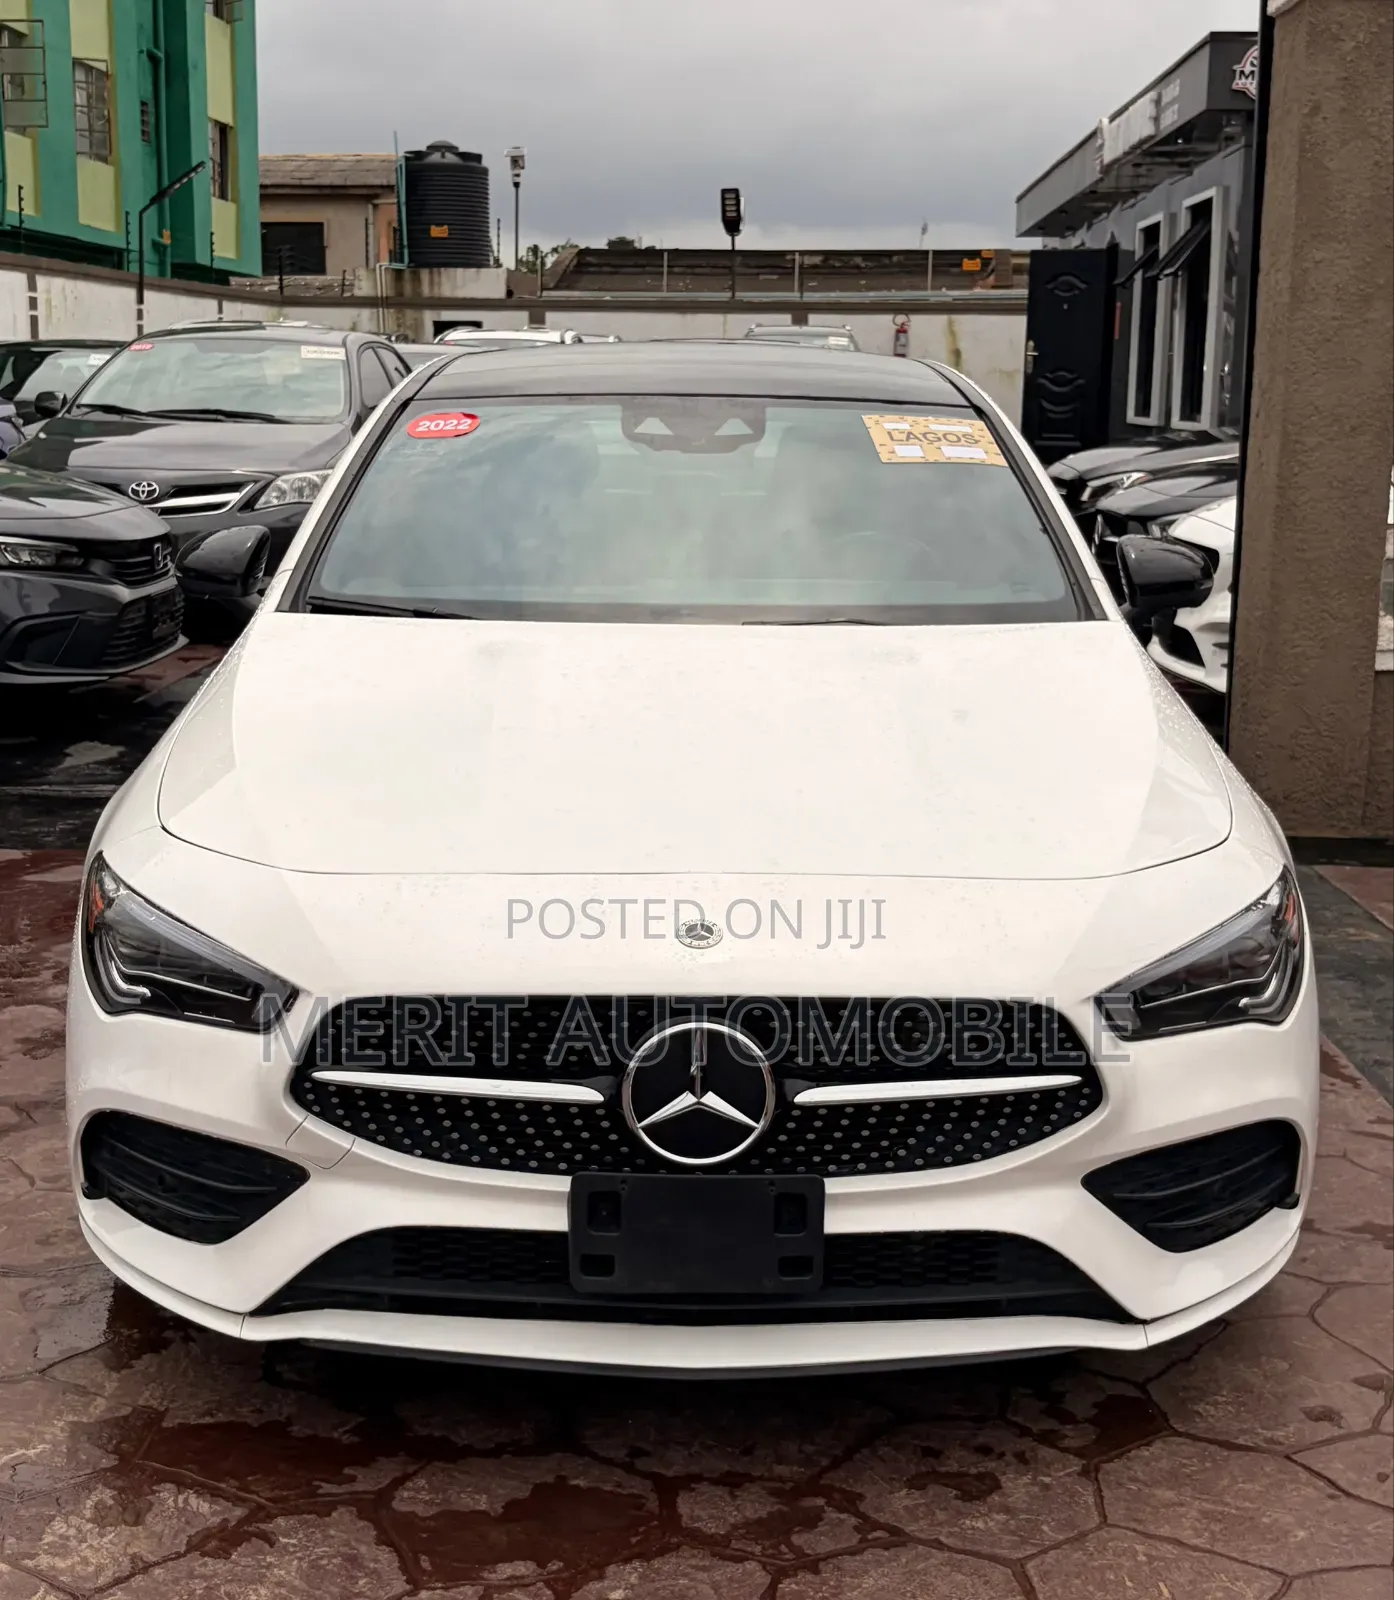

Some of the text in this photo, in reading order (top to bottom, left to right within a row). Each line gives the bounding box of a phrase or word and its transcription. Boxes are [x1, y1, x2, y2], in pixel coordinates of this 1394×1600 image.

[1239, 70, 1256, 81] M
[416, 419, 473, 432] 2022
[887, 431, 981, 445] LAGOS
